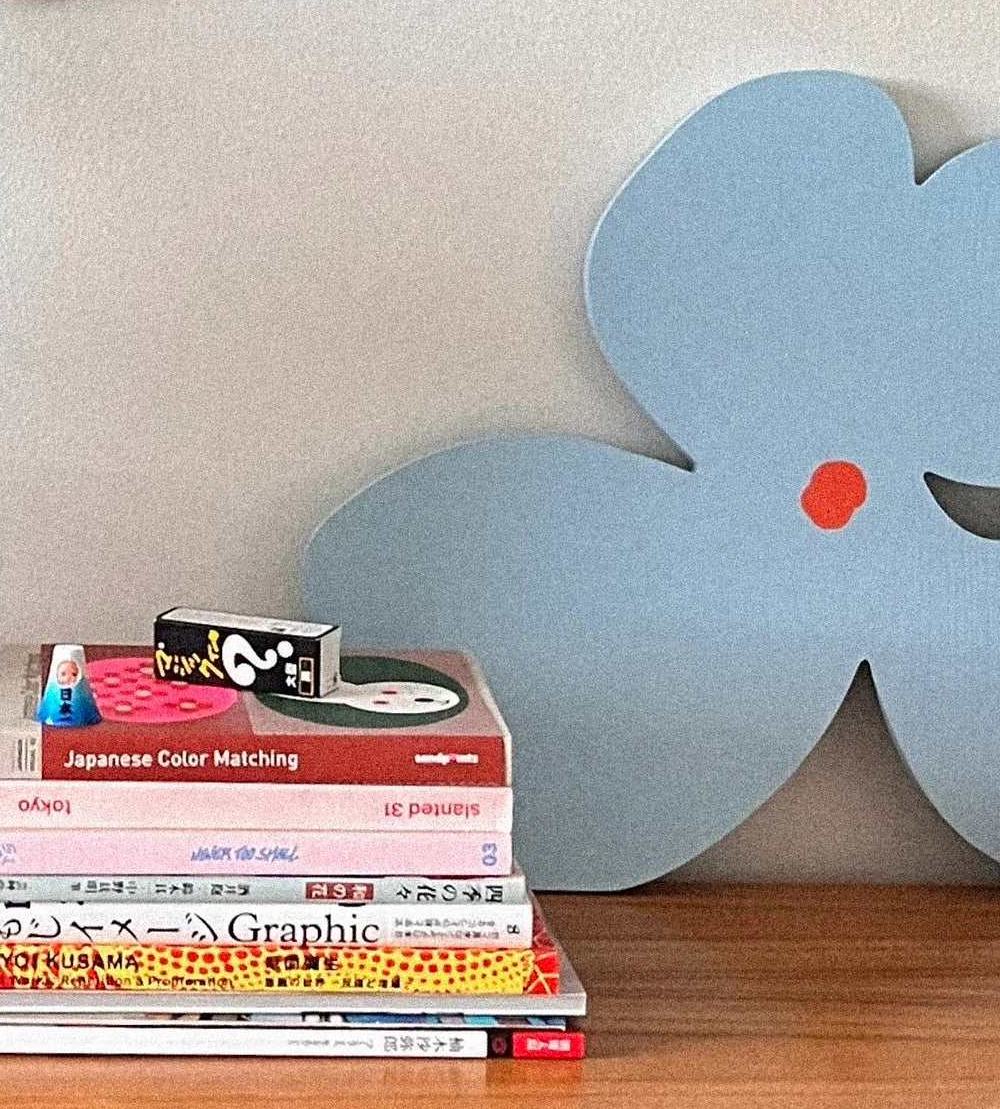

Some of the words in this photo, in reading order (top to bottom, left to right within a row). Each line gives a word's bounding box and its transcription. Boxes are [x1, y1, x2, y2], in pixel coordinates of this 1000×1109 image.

[63, 750, 153, 771] Japanese
[157, 749, 209, 768] Color
[213, 749, 299, 771] Matching
[18, 796, 71, 816] tokyo
[384, 802, 403, 817] 31
[408, 802, 480, 818] slanted
[481, 842, 498, 867] 03
[228, 912, 380, 947] Graphic
[46, 952, 139, 972] KUSAMA
